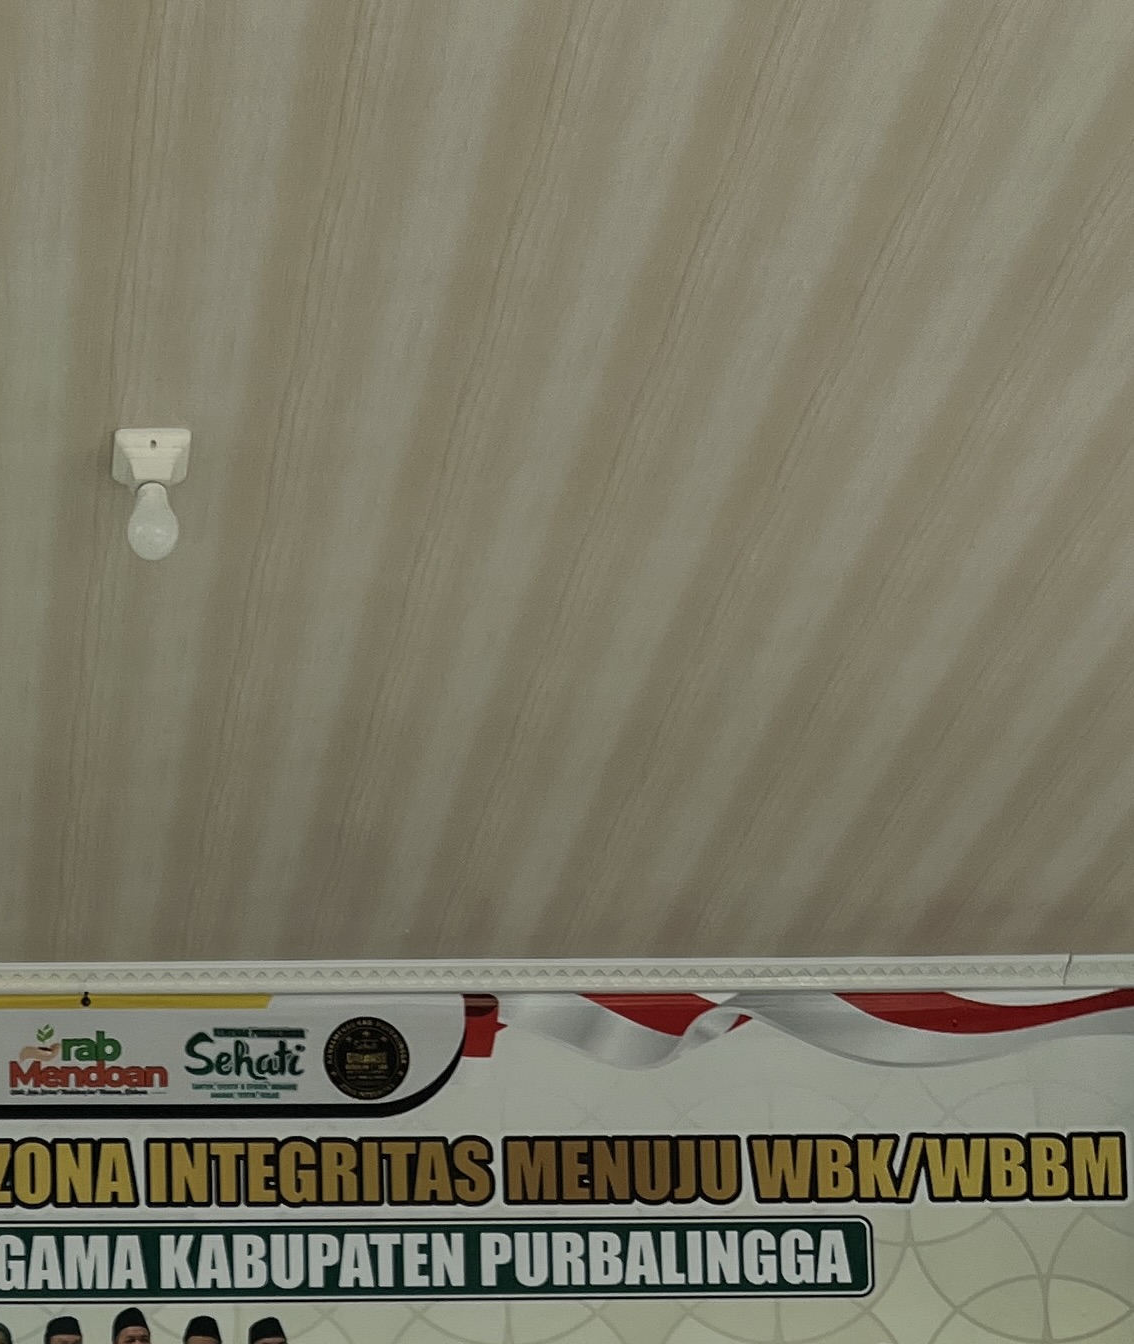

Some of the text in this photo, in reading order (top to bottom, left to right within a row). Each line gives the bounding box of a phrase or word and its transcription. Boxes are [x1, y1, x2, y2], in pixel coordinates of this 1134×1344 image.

[9, 1060, 169, 1088] Mendoan
[184, 1032, 306, 1081] Sehati
[147, 1138, 492, 1205] INTEGRITAS
[506, 1137, 740, 1203] MENUJU
[750, 1134, 1125, 1201] WBK/WBBM
[159, 1232, 466, 1290] KABUPATEN
[480, 1229, 853, 1288] PURBALINGGA
